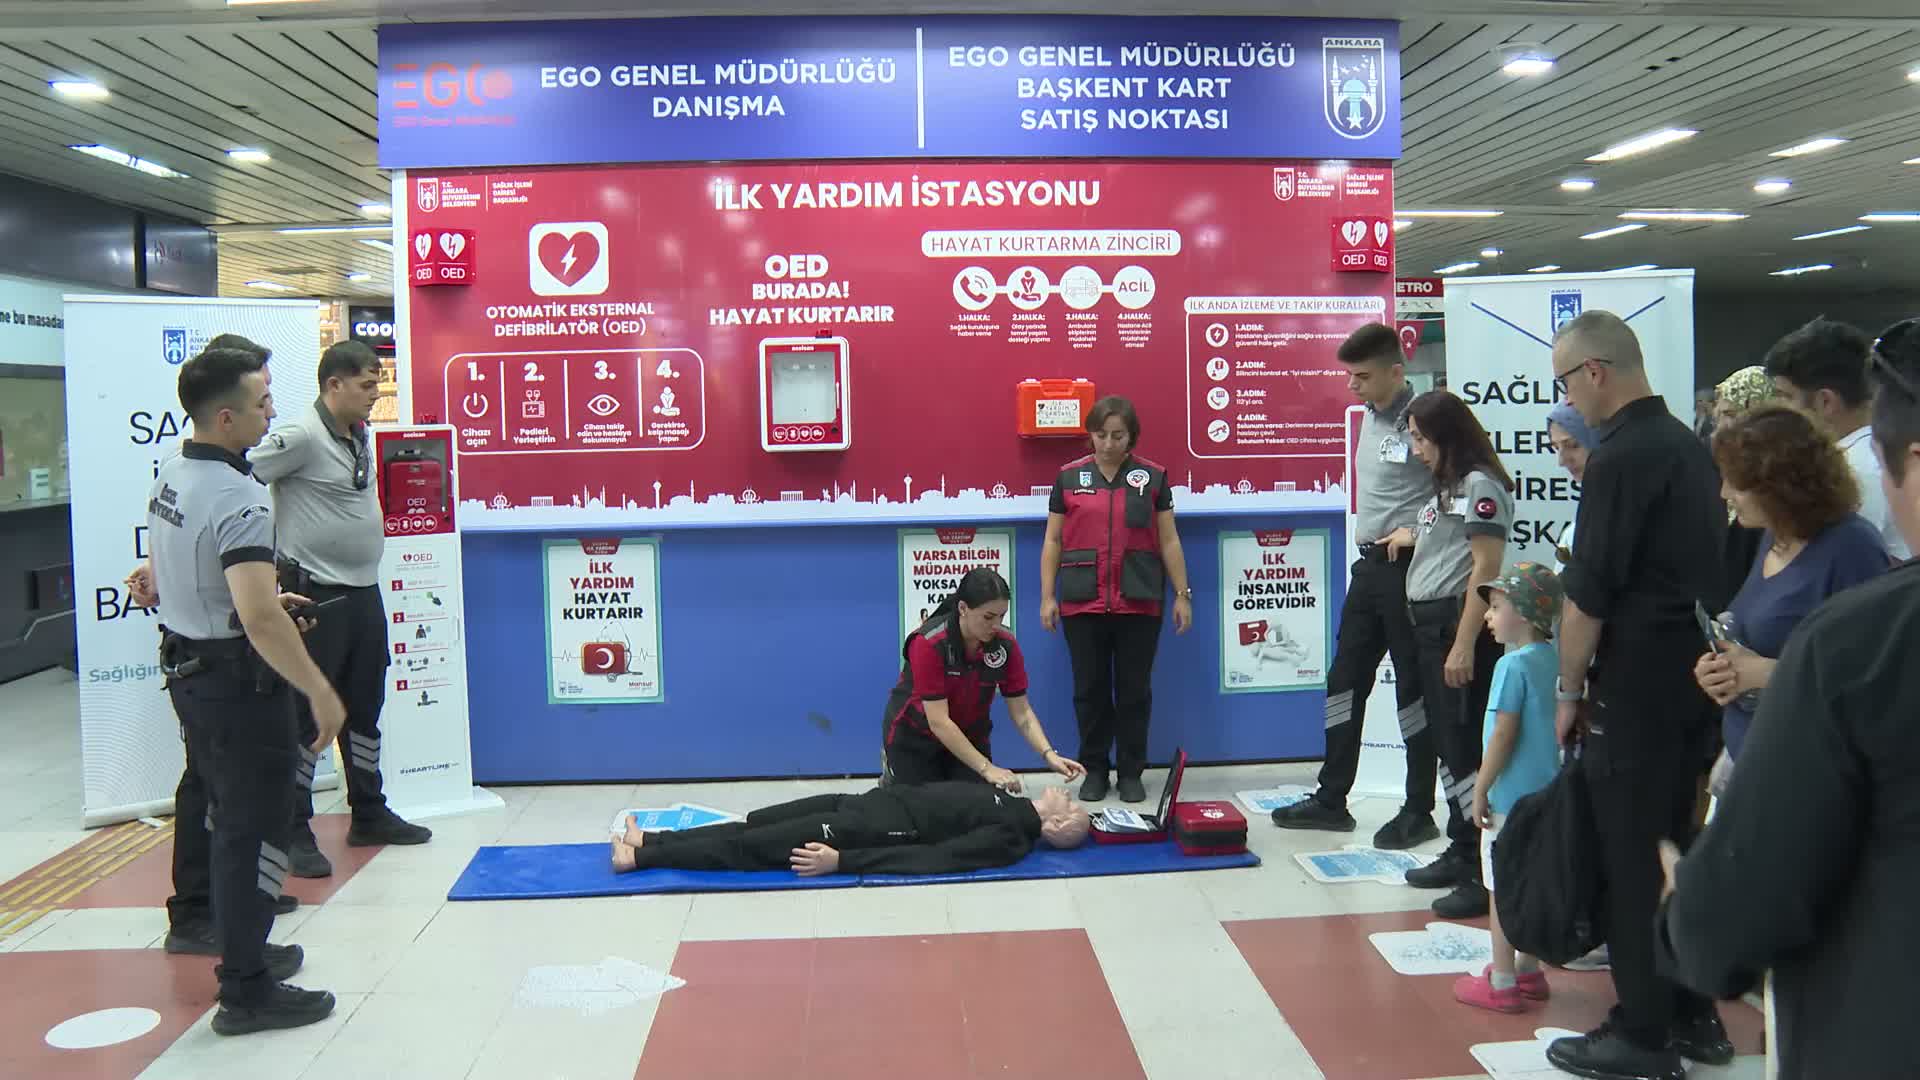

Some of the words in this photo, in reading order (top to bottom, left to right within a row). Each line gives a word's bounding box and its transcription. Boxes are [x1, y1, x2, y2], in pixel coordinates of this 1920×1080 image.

[949, 46, 1009, 67] EGO
[1018, 45, 1111, 67] GENEL
[1120, 39, 1296, 67] MÜDÜRLÜĞÜ
[540, 66, 601, 88] EGO
[611, 63, 706, 87] GENEL
[715, 55, 897, 85] MÜDÜRLÜĞÜ
[1017, 77, 1149, 103] BAŞKENT
[1157, 77, 1231, 98] KART
[652, 95, 785, 121] DANIŞMA
[1020, 108, 1099, 134] SATIŞ
[1107, 108, 1229, 130] NOKTASI
[714, 178, 764, 210] İLK
[771, 182, 903, 209] YARDIM
[911, 175, 1101, 207] İSTASYONU
[931, 236, 993, 252] HAYAT
[999, 236, 1101, 251] KURTARMA
[1106, 232, 1172, 251] ZİNCİRİ
[764, 254, 829, 279] OED
[1342, 254, 1366, 266] OED
[1374, 254, 1388, 267] OED
[416, 267, 432, 280] OED
[440, 266, 465, 280] OED
[752, 280, 850, 300] BURADA!
[1118, 279, 1150, 293] ACİL
[1396, 281, 1433, 293] ETRO
[485, 300, 567, 319] OTOMATİK
[570, 301, 655, 317] EKSTERNAL
[1190, 300, 1204, 311] İLK
[1209, 301, 1237, 311] ANDA
[1278, 300, 1291, 310] VE
[13, 309, 25, 325] bu
[709, 306, 785, 327] HAYAT
[788, 305, 895, 325] KURTARIR
[494, 318, 600, 337] DEFİBRİLATÖR
[602, 317, 647, 336] (OED)
[467, 361, 486, 381] 1.
[523, 361, 545, 382] 2.
[594, 360, 617, 381] 3.
[656, 359, 681, 379] 4.
[461, 427, 491, 439] Cihazı
[413, 553, 432, 562] OED
[913, 549, 957, 561] VARSA
[959, 547, 1000, 561] BİLGİN
[1263, 550, 1286, 565] İLK
[589, 559, 613, 574] İLK
[913, 562, 981, 576] MÜDAHA
[1243, 567, 1305, 581] YARDIM
[570, 576, 635, 590] YARDIM
[913, 579, 958, 590] YOKSA
[1238, 580, 1310, 596] İNSANLIK
[575, 591, 632, 605] HAYAT
[1233, 594, 1317, 611] GÖREVİDİR
[563, 606, 643, 620] KURTARIR
